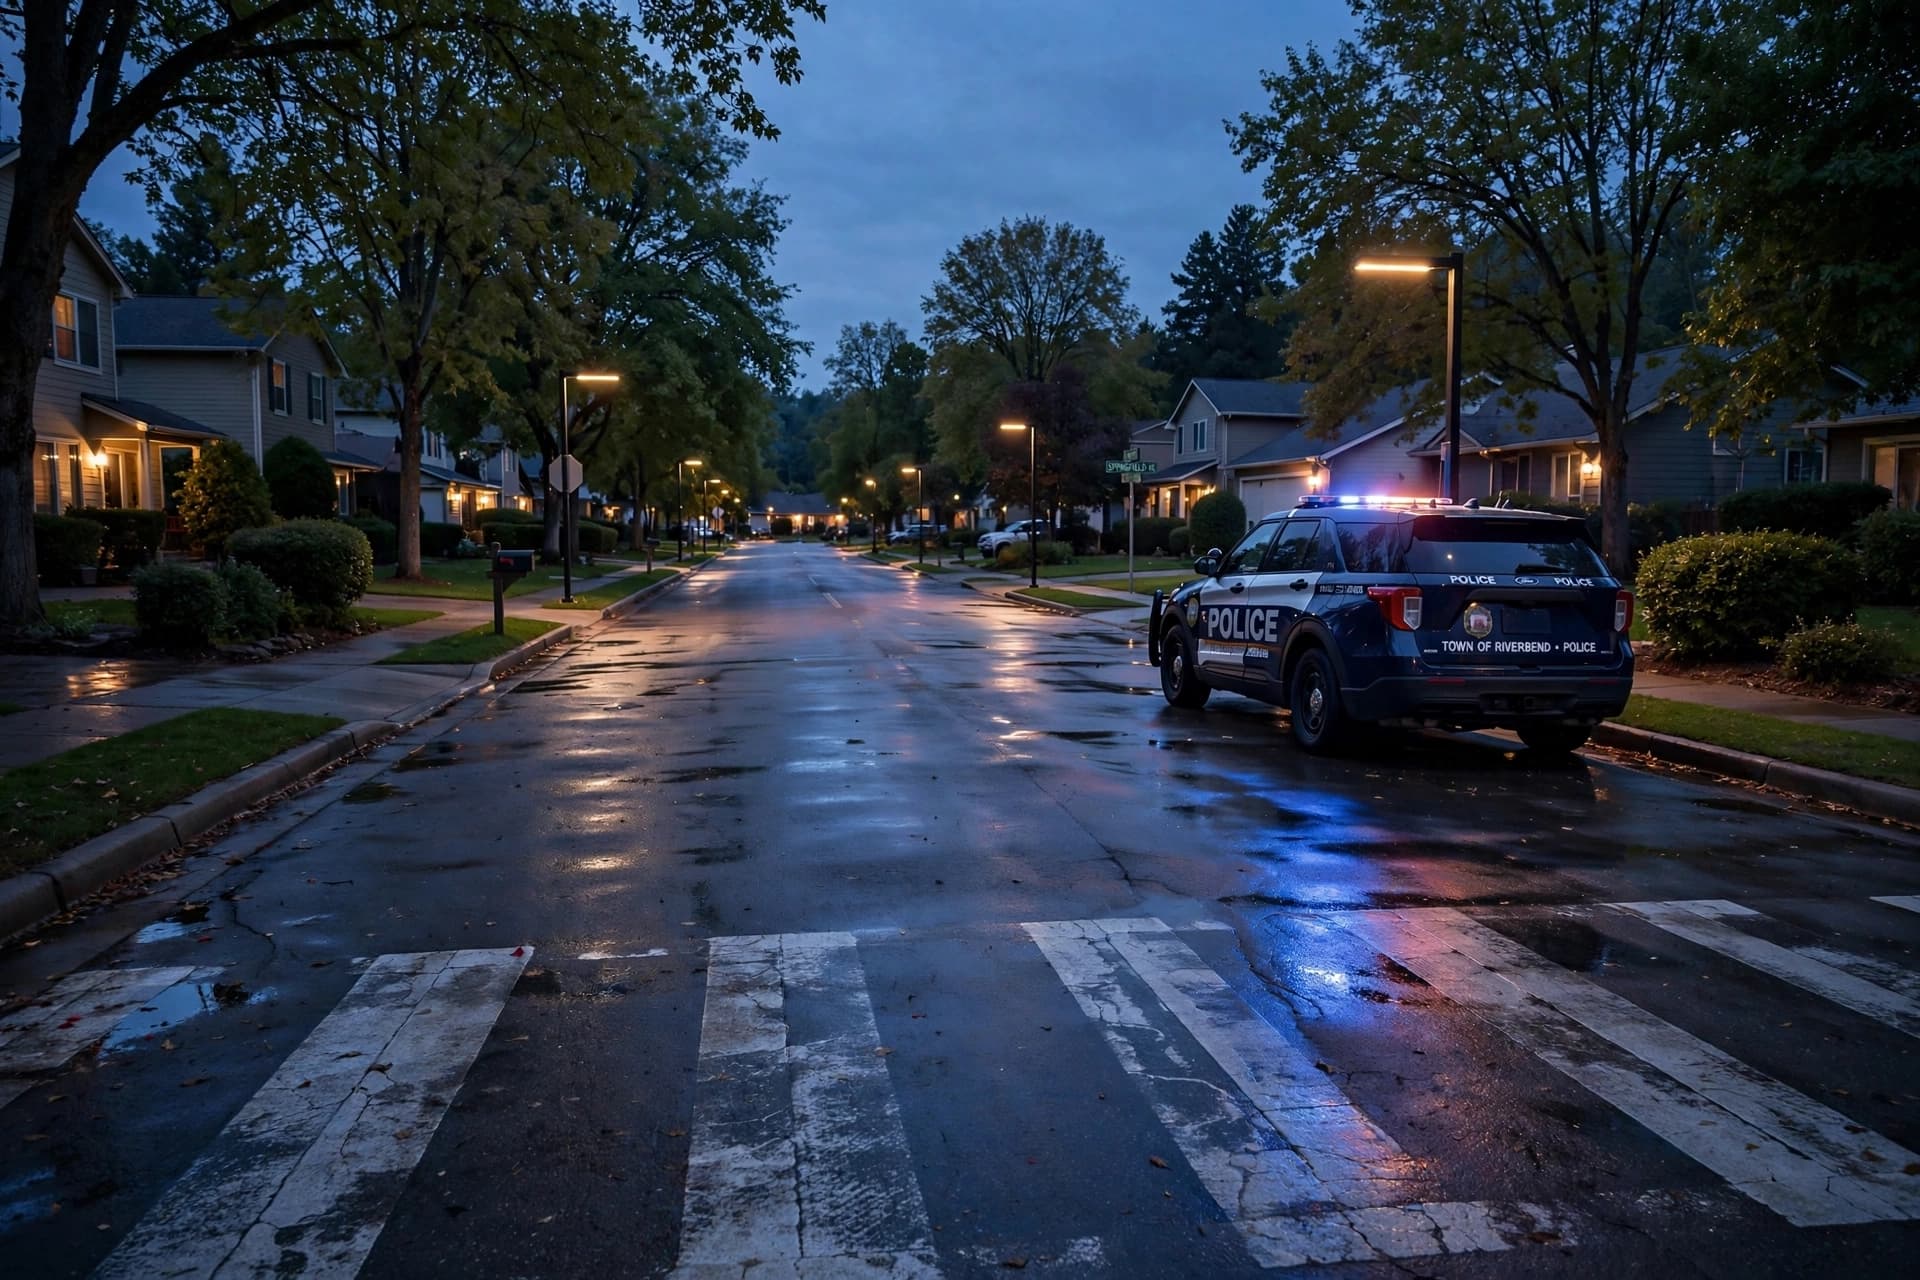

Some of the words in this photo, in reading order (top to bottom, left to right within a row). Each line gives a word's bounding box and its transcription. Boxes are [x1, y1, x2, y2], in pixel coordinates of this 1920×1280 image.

[1450, 575, 1496, 585] POLICE
[1554, 577, 1594, 587] POLICE
[1207, 607, 1280, 642] POLICE
[1442, 640, 1474, 652] TOWN
[1477, 641, 1492, 652] OF
[1494, 641, 1551, 653] RIVERBEND
[1563, 642, 1596, 653] POLICE
